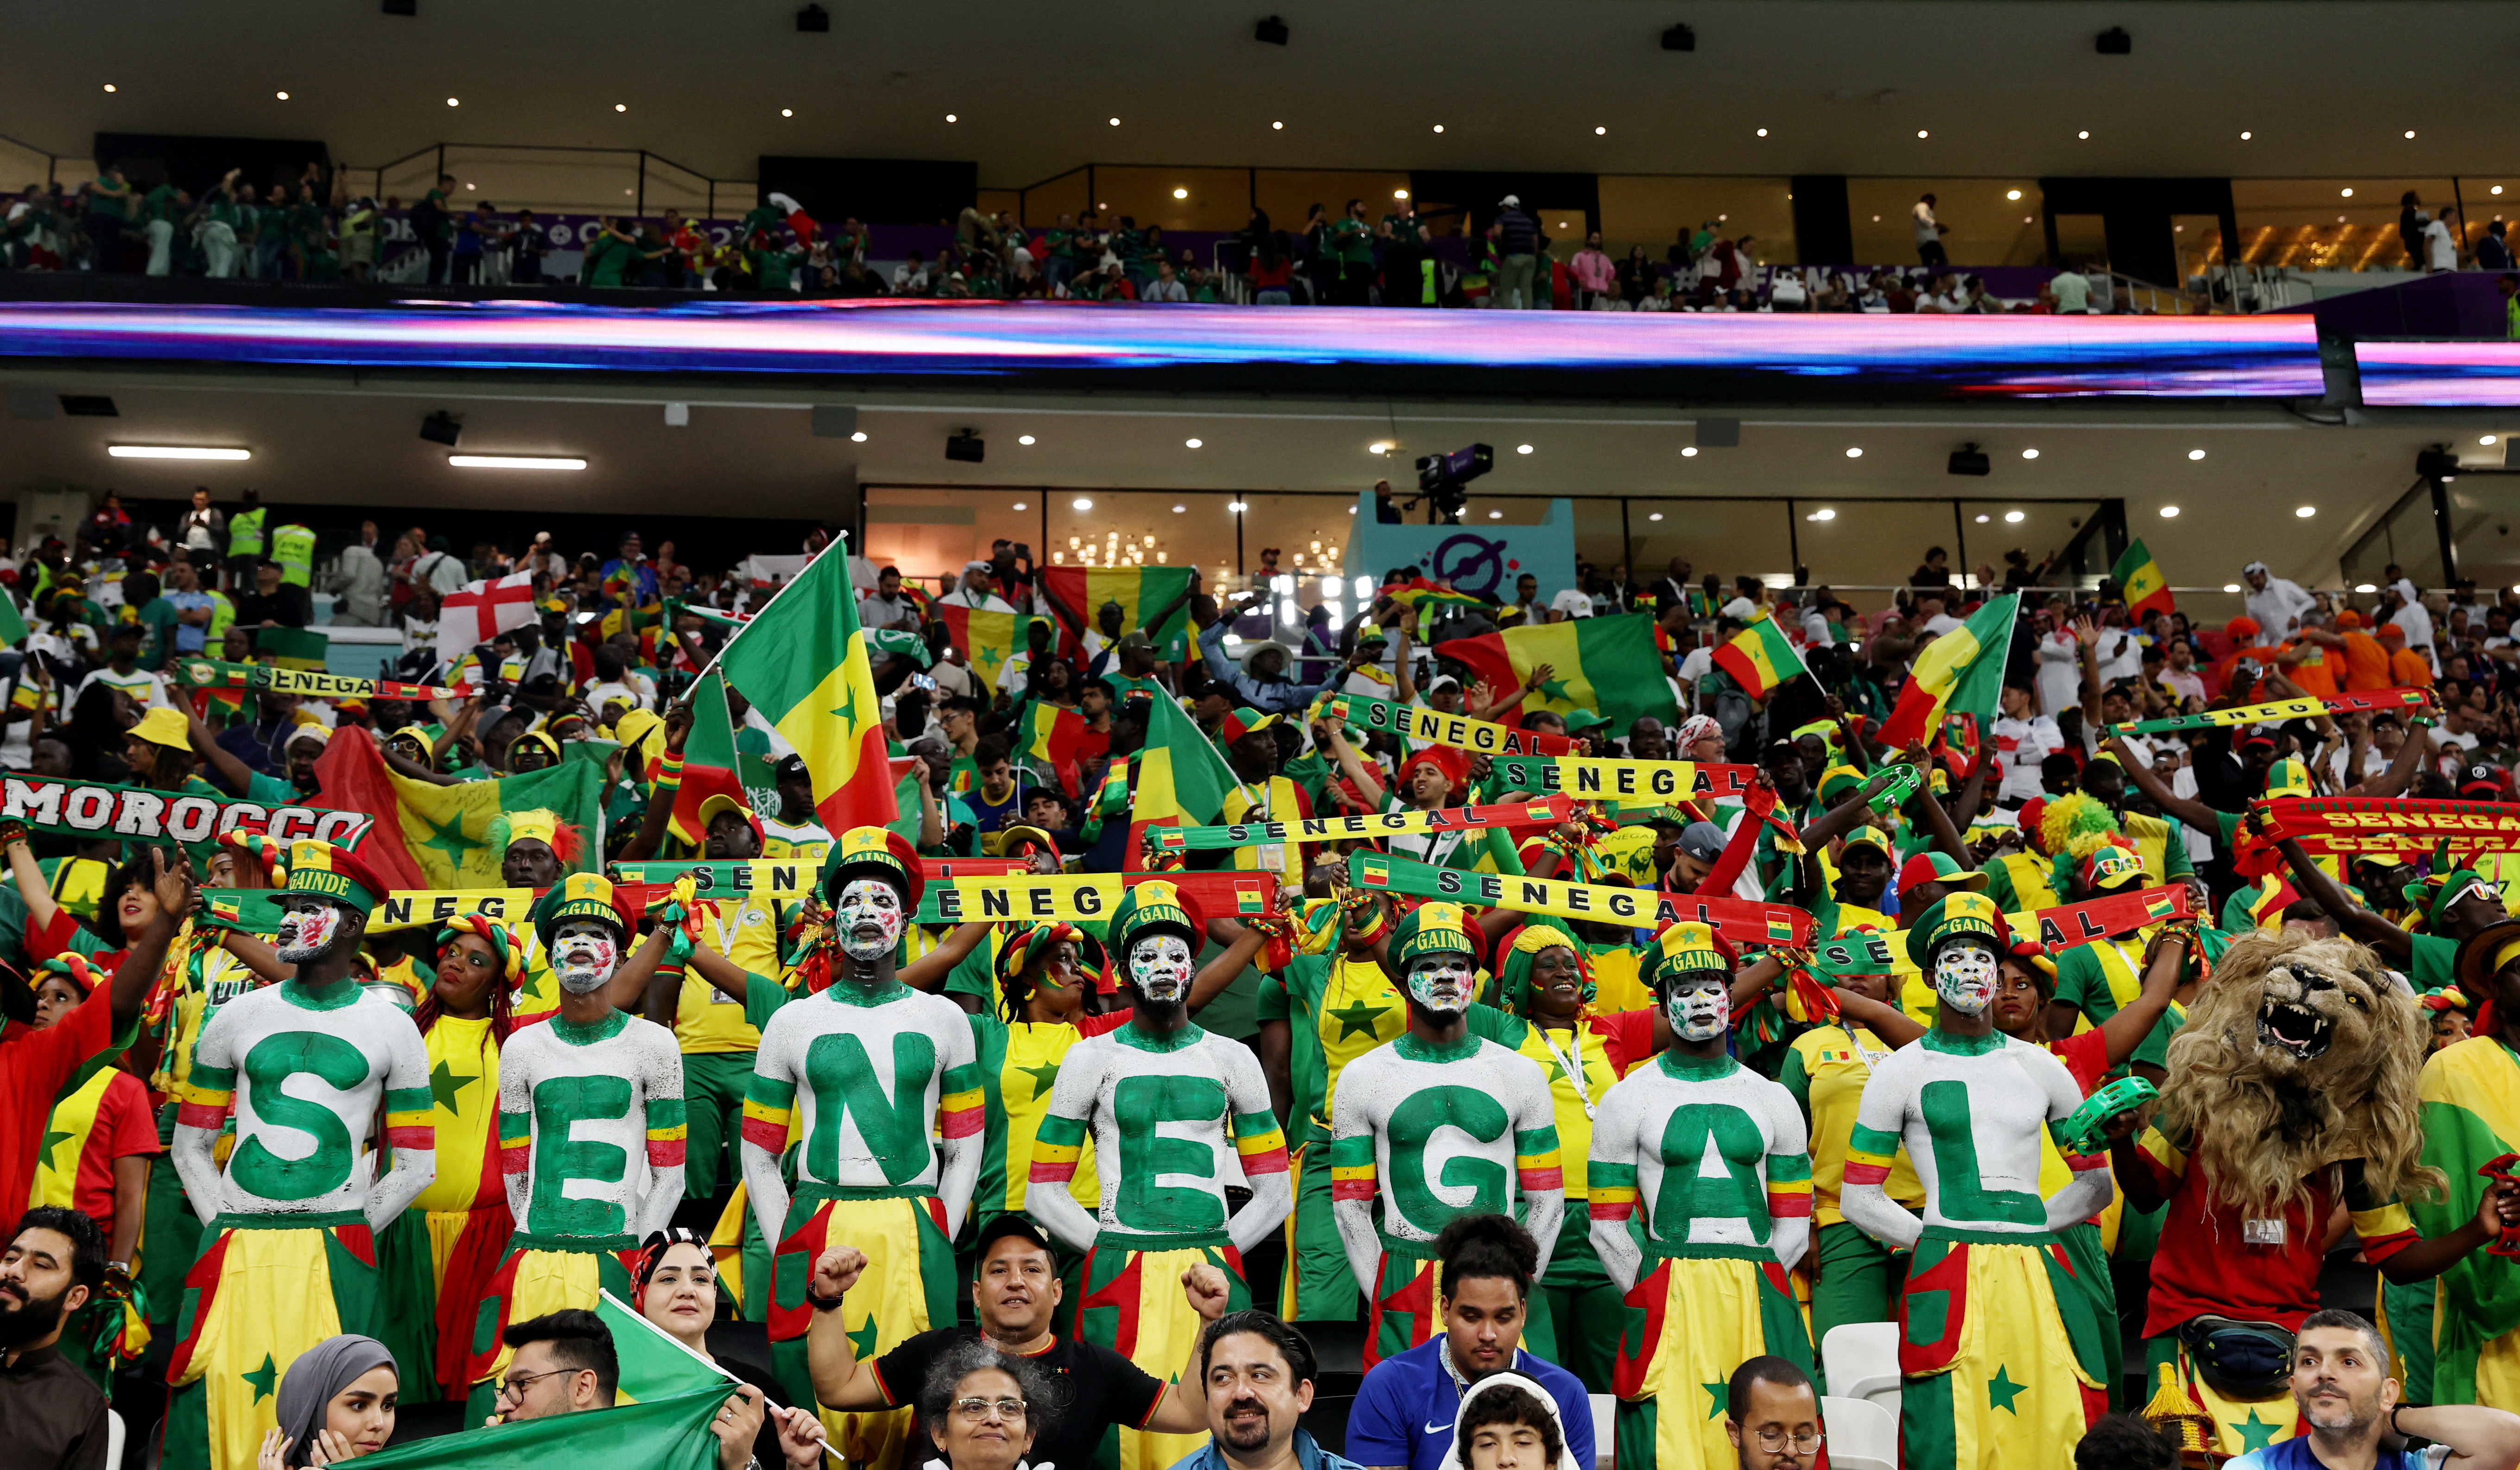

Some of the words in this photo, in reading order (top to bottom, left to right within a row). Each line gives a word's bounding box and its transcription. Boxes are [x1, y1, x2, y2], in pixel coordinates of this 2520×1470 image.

[253, 665, 394, 695] SENEGAL
[1368, 702, 1547, 756] SENEGAL
[1, 778, 365, 850] MOROCCO
[1227, 806, 1487, 842] SENEGAL
[1507, 763, 1747, 794] SENEGAL
[2325, 837, 2520, 851] SENEG
[1436, 871, 1721, 928] SENEGAL
[230, 1031, 369, 1200] S
[528, 1075, 632, 1237] E
[805, 1031, 935, 1186] N
[1114, 1075, 1226, 1233] E
[1387, 1085, 1509, 1234] G
[1921, 1080, 2048, 1225] L
[1653, 1103, 1772, 1245] A
